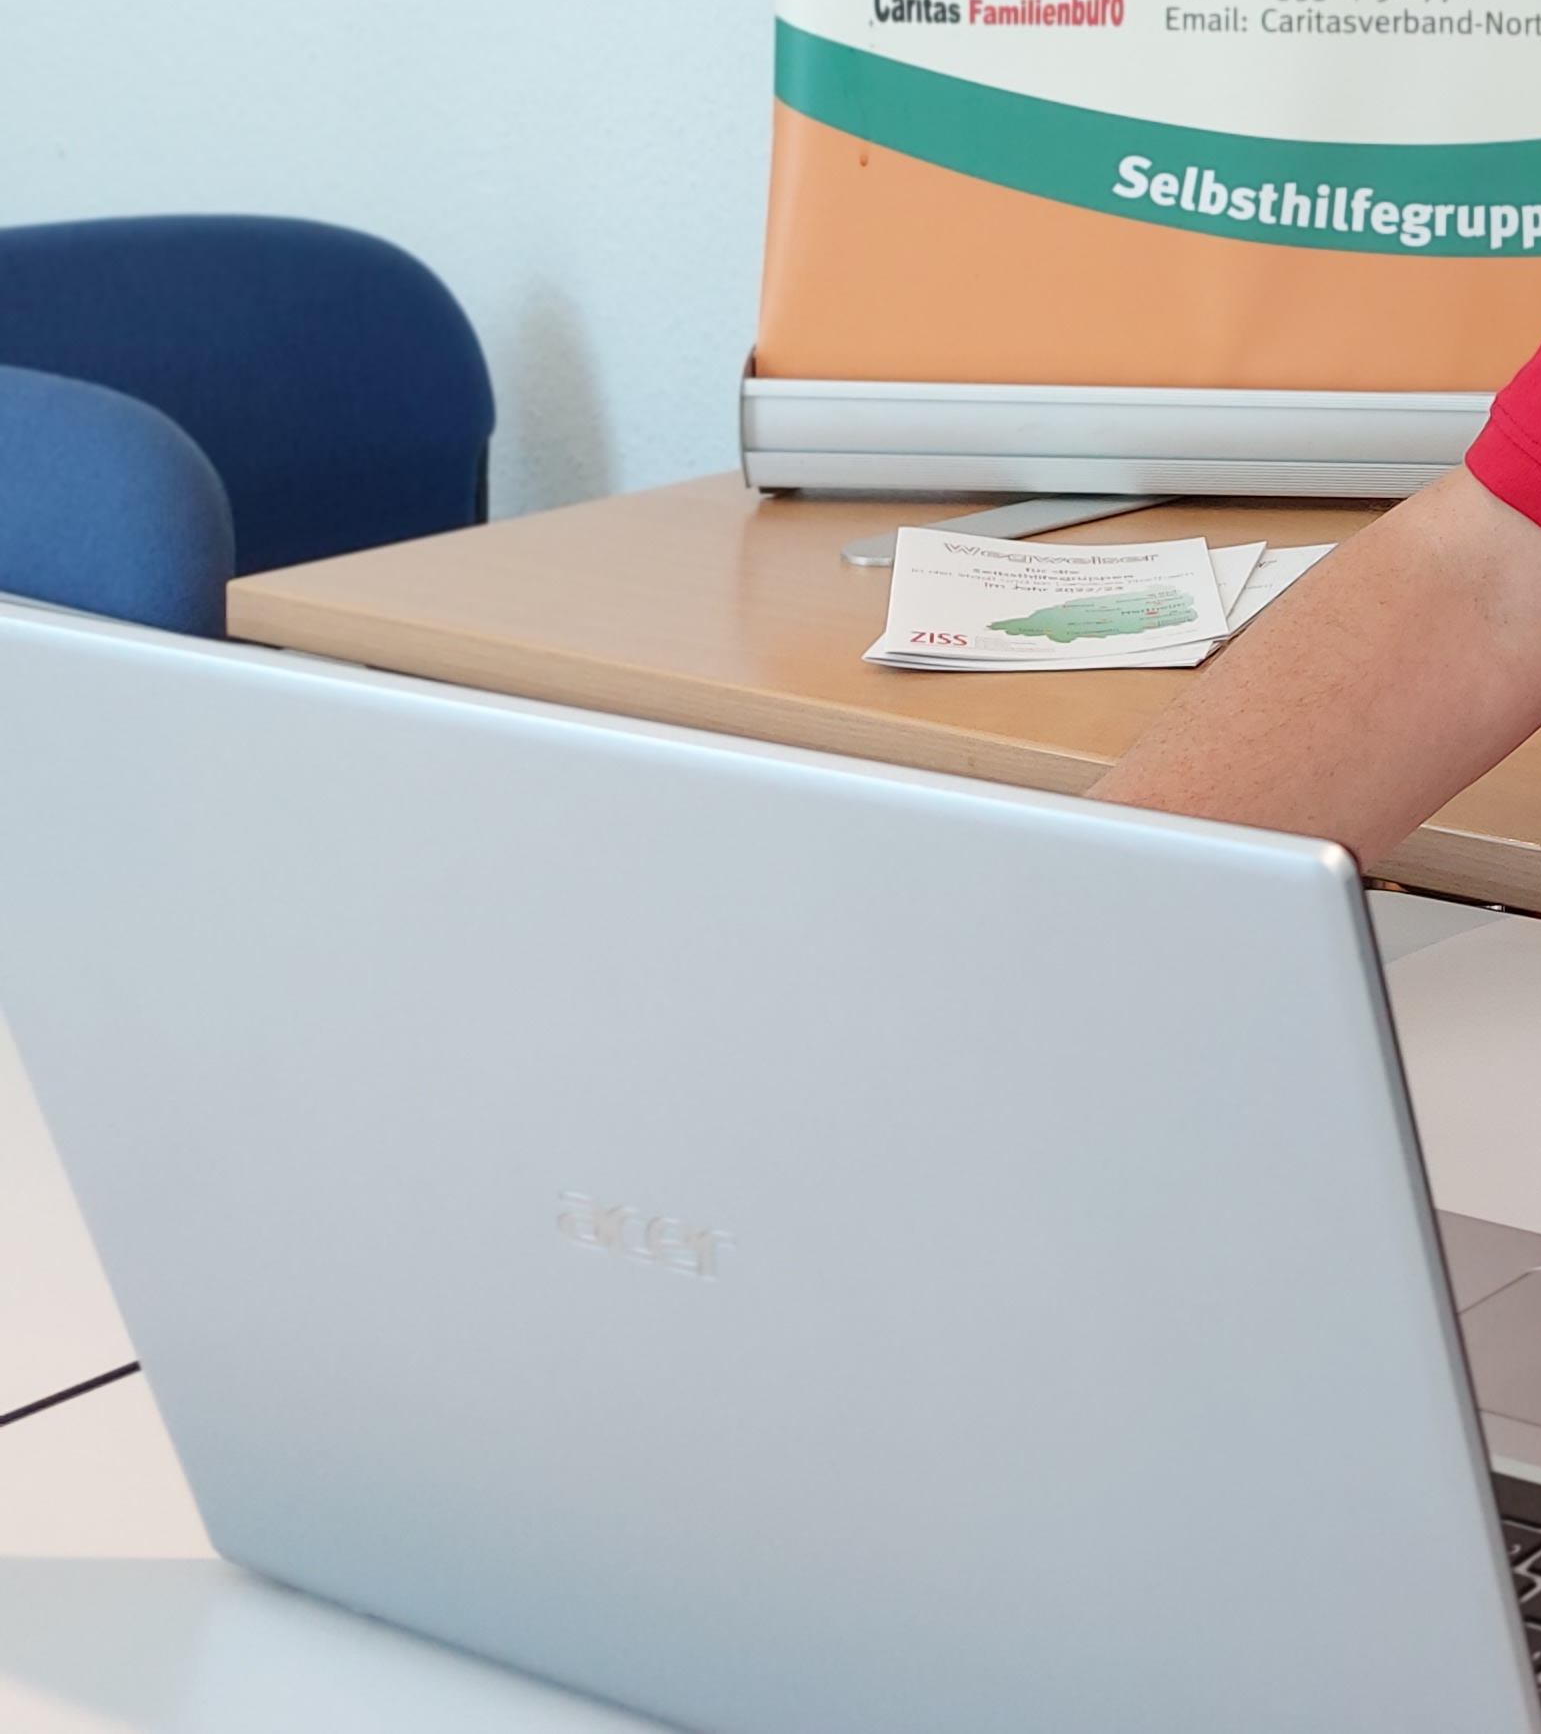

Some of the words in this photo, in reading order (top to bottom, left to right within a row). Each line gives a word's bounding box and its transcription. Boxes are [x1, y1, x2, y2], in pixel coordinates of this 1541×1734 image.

[1166, 6, 1247, 32] Email:
[943, 541, 1160, 566] Wegweiser
[909, 630, 969, 647] ZISS
[555, 1191, 737, 1283] acer
